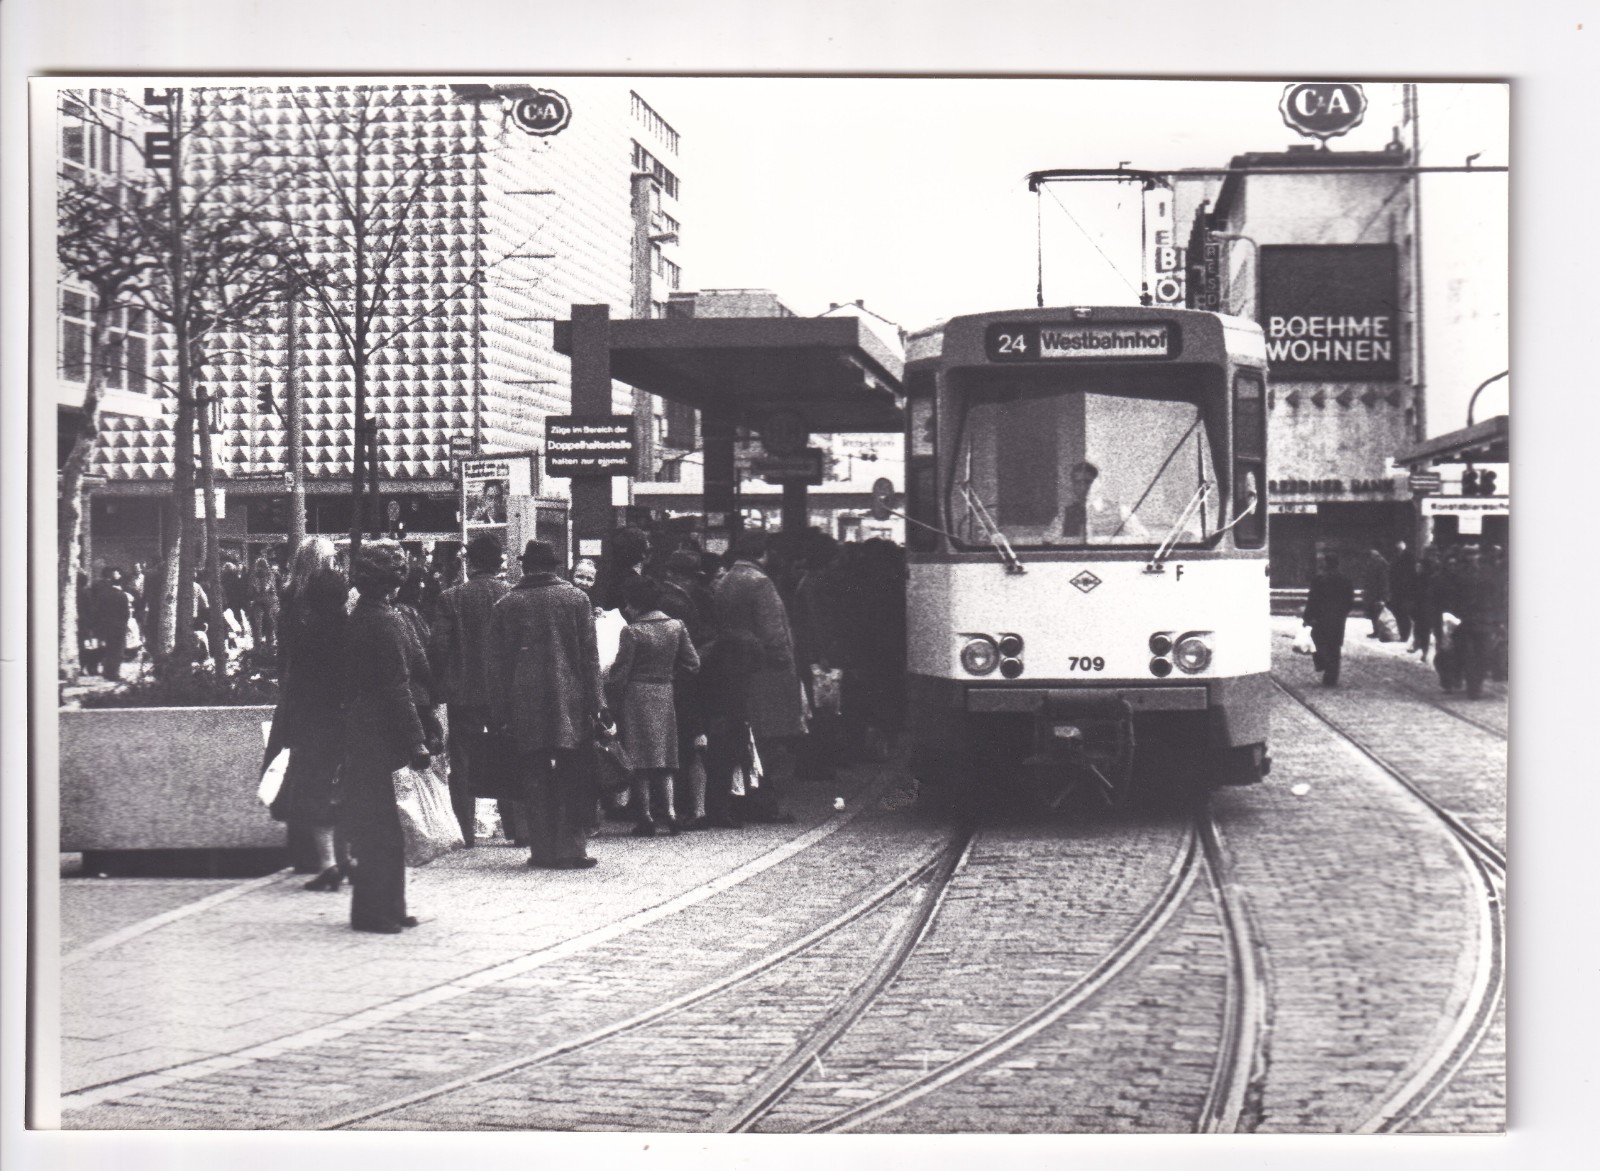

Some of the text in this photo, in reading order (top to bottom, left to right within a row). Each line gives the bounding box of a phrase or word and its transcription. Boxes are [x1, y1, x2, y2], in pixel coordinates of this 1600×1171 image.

[1295, 88, 1351, 116] C&A
[523, 103, 558, 120] C&A
[1270, 315, 1389, 337] BOEHME
[998, 330, 1167, 353] 24 Westbahnhof
[1265, 339, 1391, 361] WOHNEN
[551, 426, 571, 435] Züge
[583, 426, 613, 434] Bereich
[548, 440, 632, 451] Doppelhaltestelle
[1351, 479, 1395, 495] BANK
[1176, 564, 1184, 582] F
[1068, 656, 1105, 671] 709
